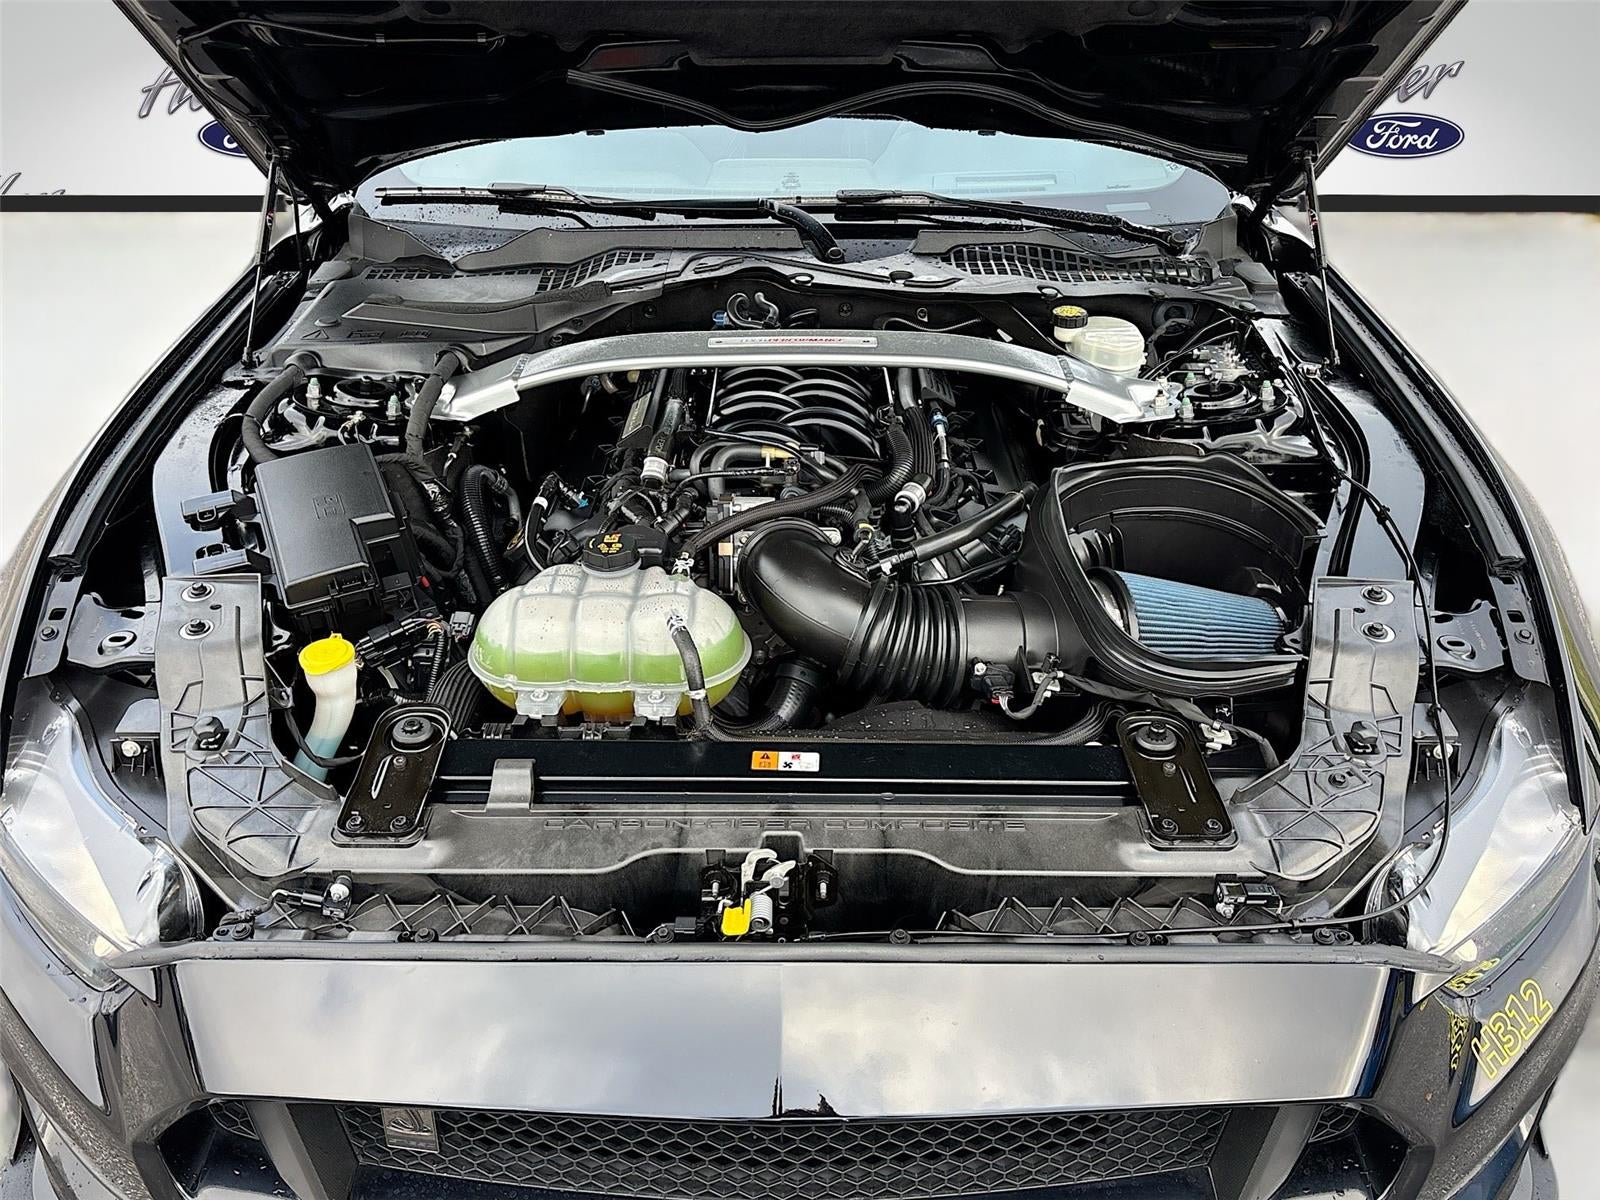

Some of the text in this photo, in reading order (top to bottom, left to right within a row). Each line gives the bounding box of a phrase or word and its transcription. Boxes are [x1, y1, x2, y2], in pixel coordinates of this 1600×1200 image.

[1365, 119, 1440, 150] Ford
[823, 818, 1027, 832] COMPOSITE
[1471, 979, 1553, 1079] H312
